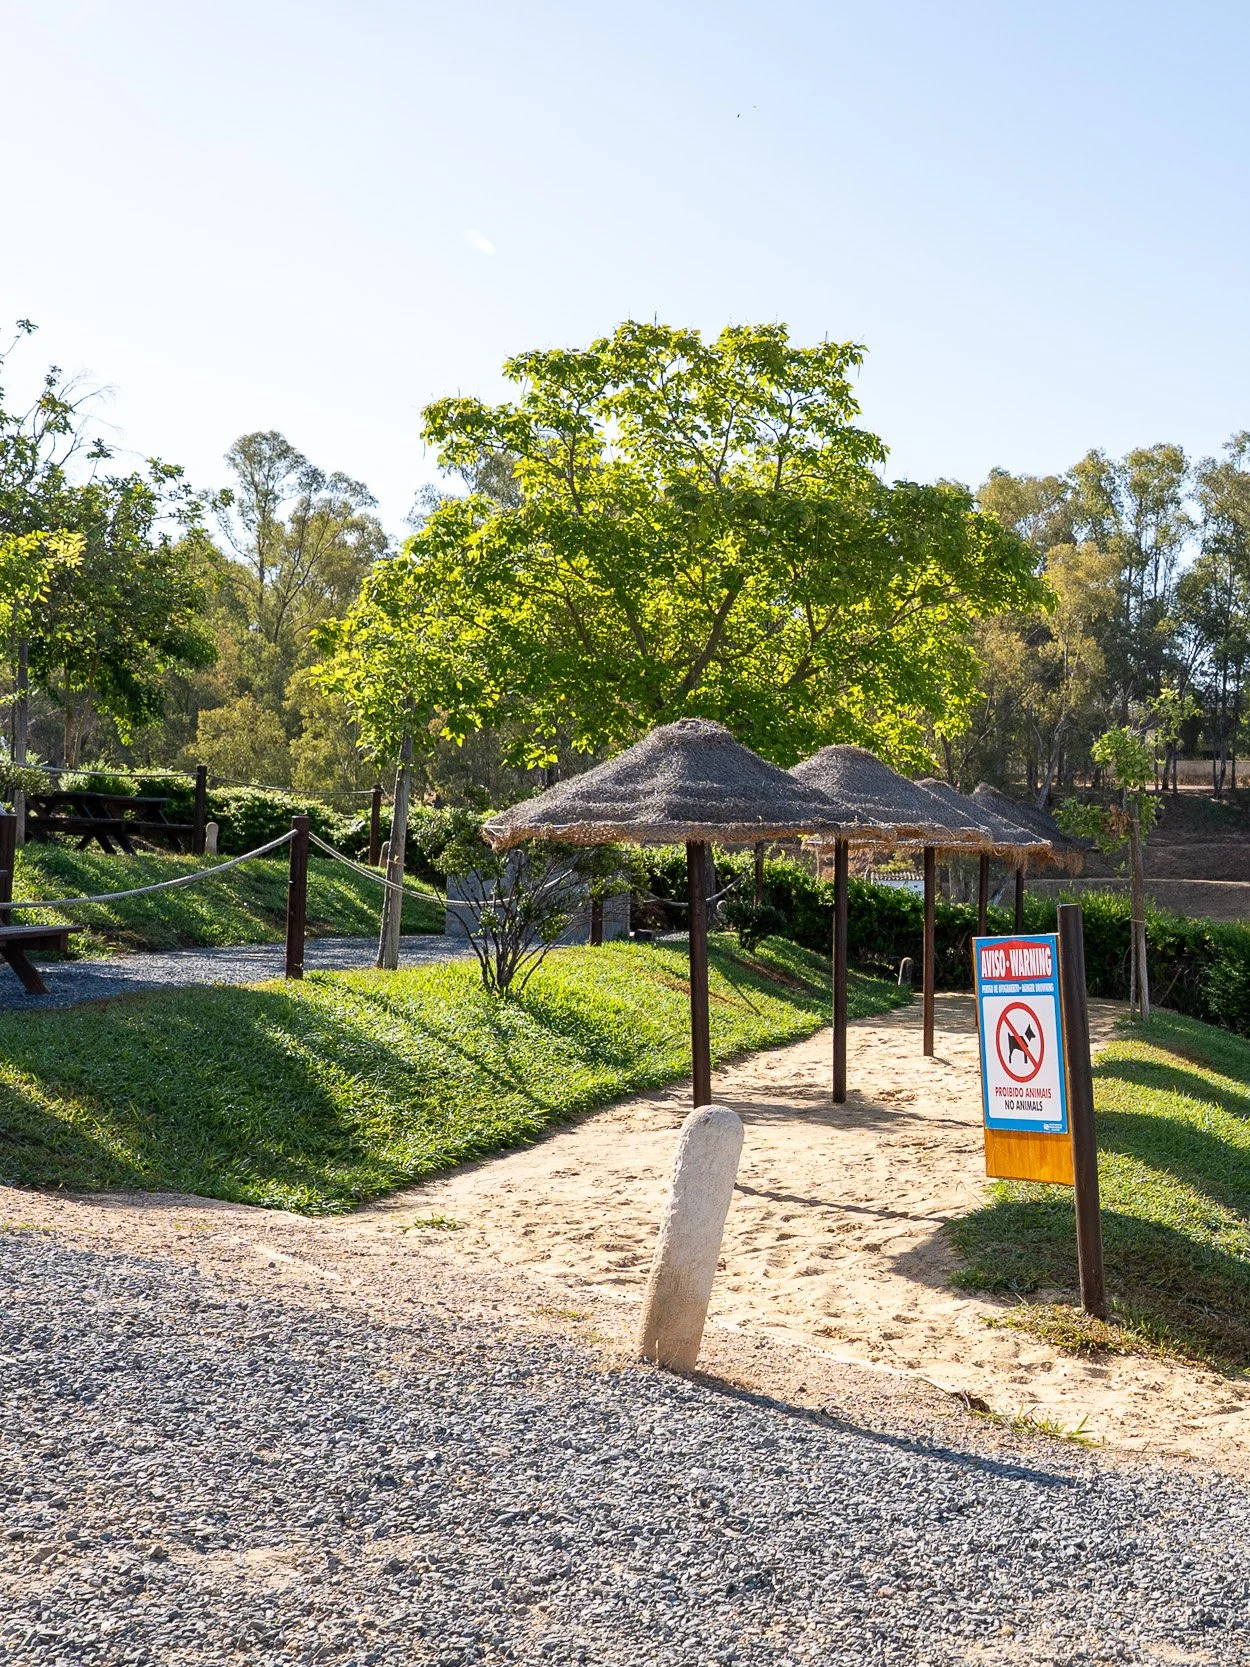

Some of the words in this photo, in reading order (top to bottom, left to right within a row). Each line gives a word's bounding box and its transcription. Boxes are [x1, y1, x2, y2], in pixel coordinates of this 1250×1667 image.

[982, 949, 1006, 978] AVISO
[1009, 947, 1052, 977] WARNING
[994, 1086, 1024, 1098] PROIBIDO
[1025, 1087, 1052, 1099] ANIMAIS
[1004, 1099, 1015, 1110] NO
[1016, 1100, 1043, 1112] ANIMALS
